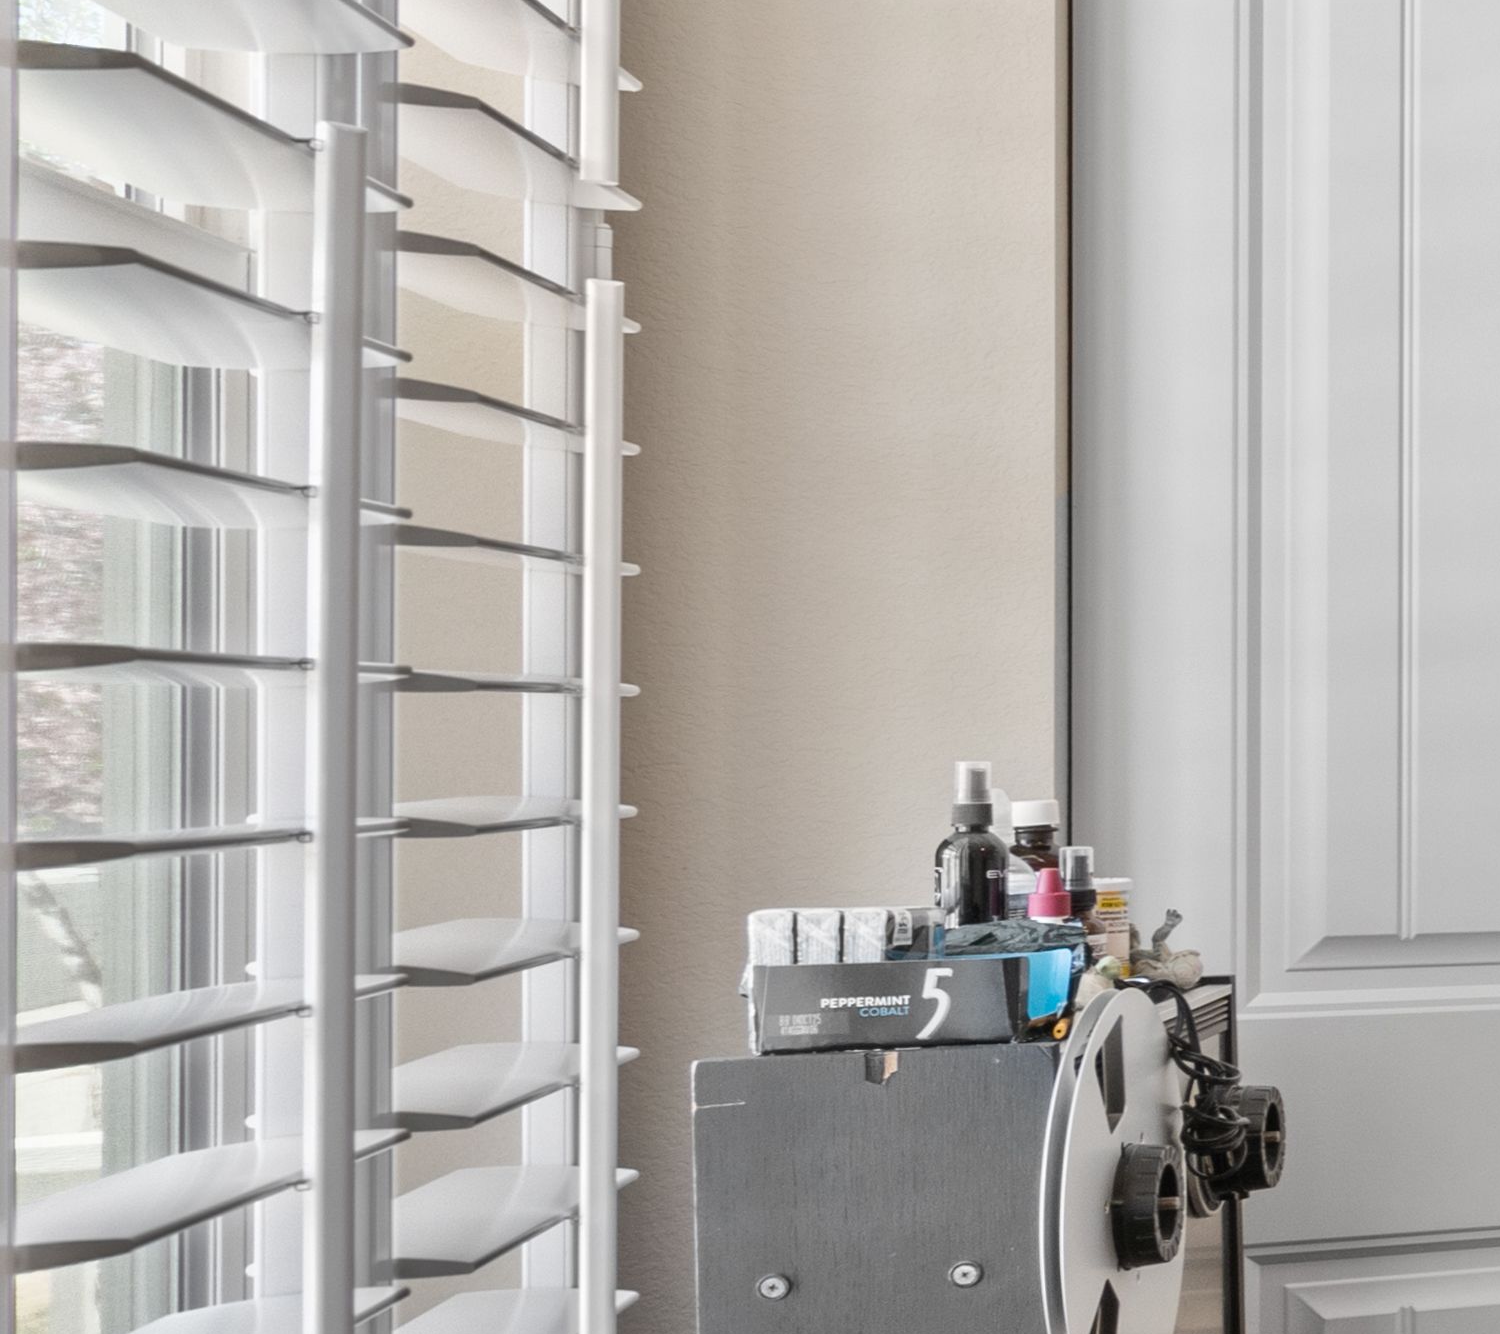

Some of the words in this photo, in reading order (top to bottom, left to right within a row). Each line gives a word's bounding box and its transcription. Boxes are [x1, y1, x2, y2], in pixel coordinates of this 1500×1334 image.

[820, 995, 911, 1009] PEPPERMINT
[915, 967, 954, 1040] 5
[859, 1006, 911, 1017] COBALT
